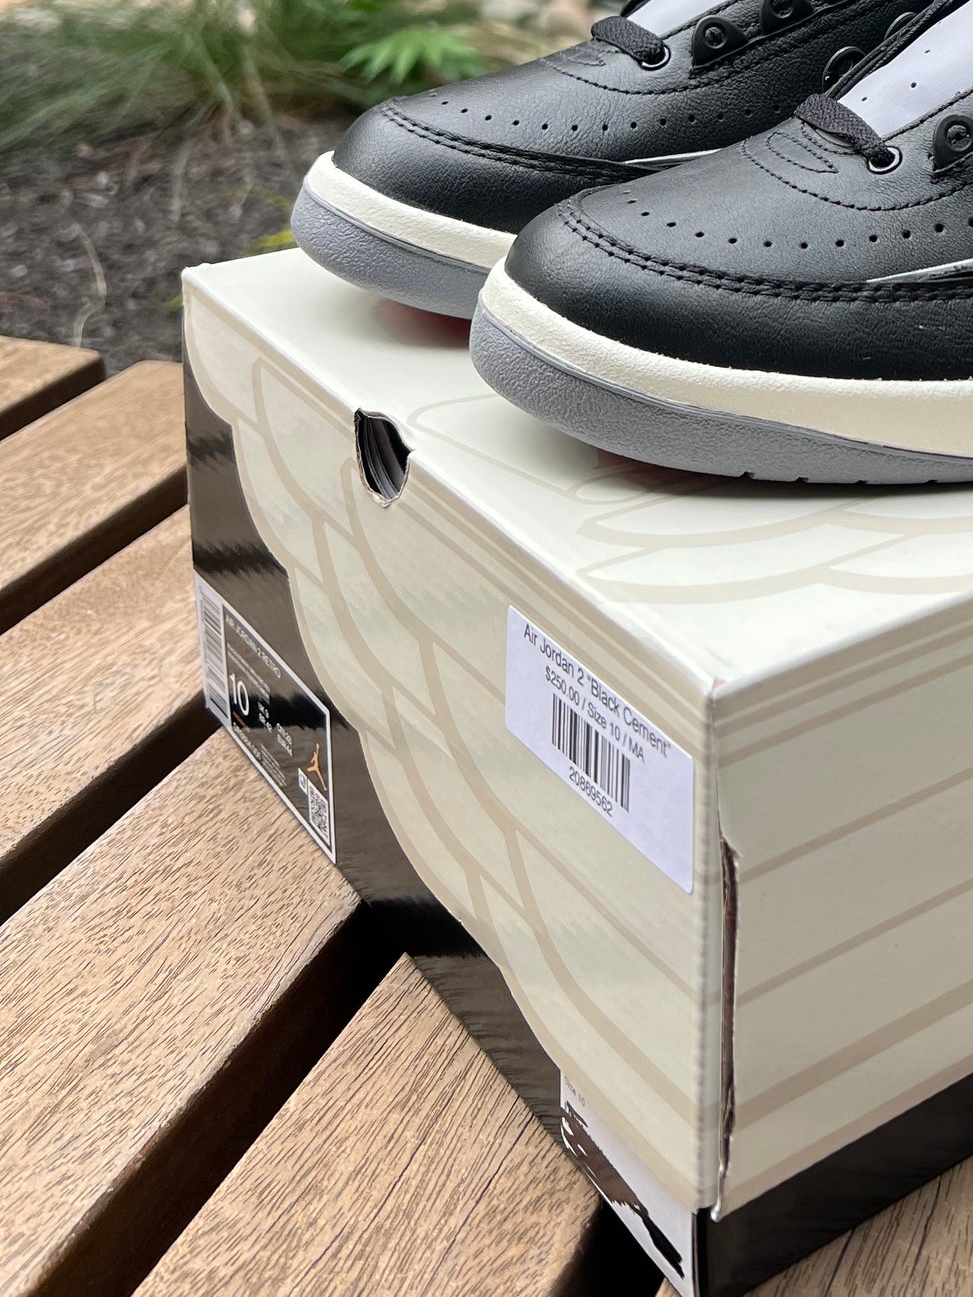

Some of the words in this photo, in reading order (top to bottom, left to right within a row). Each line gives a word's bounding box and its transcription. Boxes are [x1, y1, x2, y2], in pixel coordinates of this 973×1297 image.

[229, 673, 250, 716] 10
[523, 623, 538, 647] Air
[539, 637, 575, 679] Jordan
[577, 667, 585, 687] 2
[587, 674, 621, 719] "Black
[623, 706, 672, 759] Cement"
[545, 665, 580, 706] $250.00
[587, 701, 607, 729] Size
[610, 722, 621, 742] 10
[628, 736, 645, 764] MA
[569, 766, 613, 817] 20869562
